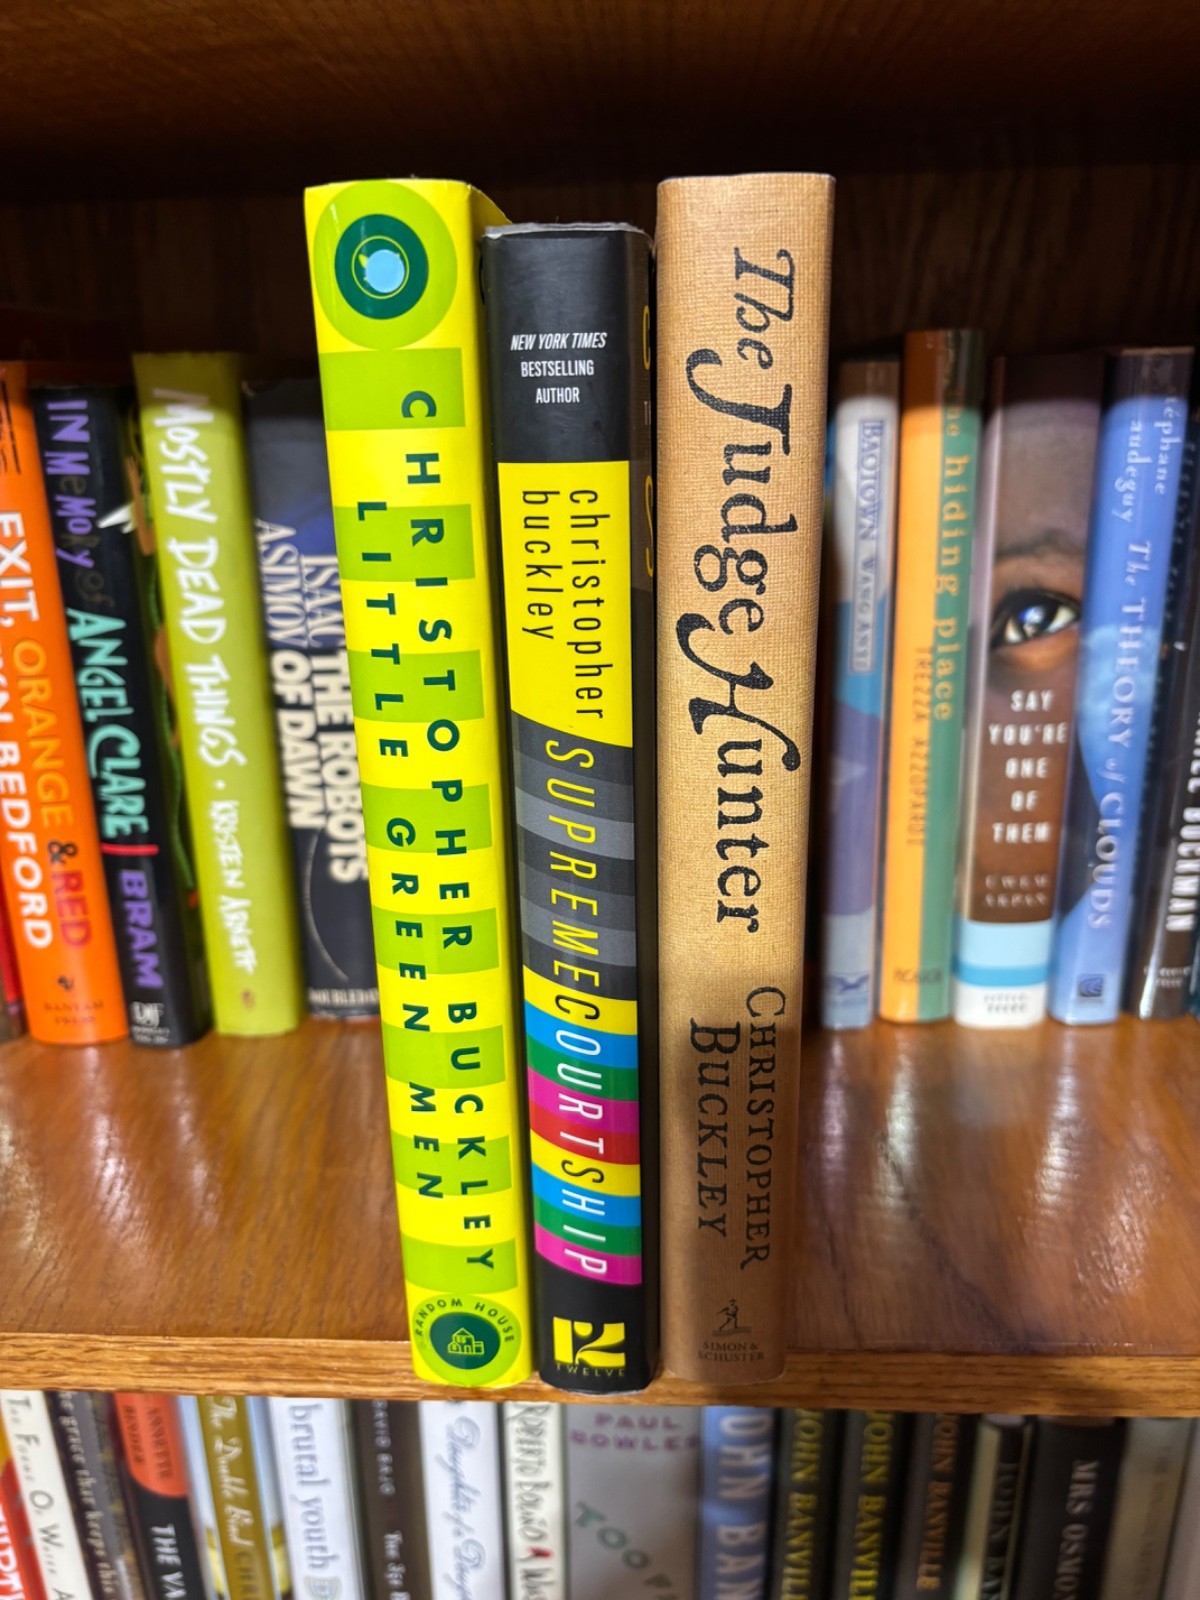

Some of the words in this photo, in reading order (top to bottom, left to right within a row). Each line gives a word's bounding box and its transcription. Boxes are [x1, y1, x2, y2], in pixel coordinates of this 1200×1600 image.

[511, 334, 535, 351] NEW
[538, 333, 570, 350] YORK
[571, 332, 608, 349] TIMES
[734, 247, 796, 369] The
[520, 360, 595, 378] BESTSELLING
[535, 387, 581, 404] AUTHOR
[46, 399, 90, 443] IN
[152, 388, 217, 524] MOSTLY
[1154, 395, 1183, 496] téphane
[685, 348, 798, 635] Judge
[937, 453, 971, 597] hiding
[167, 536, 227, 644] DEAD
[254, 518, 308, 648] ASIMOV
[301, 554, 346, 647] ISAAC
[521, 490, 563, 640] buckley
[567, 489, 614, 719] christopher
[66, 608, 133, 722] ANGEL
[271, 650, 314, 704] OF
[312, 650, 354, 732] THE
[931, 616, 959, 720] place
[1010, 689, 1055, 712] SAY
[12, 637, 73, 828] ORANGE
[186, 655, 247, 766] THINGS
[988, 722, 1068, 746] YOU'RE
[88, 724, 149, 838] CLARE
[277, 709, 325, 829] DAWN
[320, 734, 370, 883] ROBOTS
[676, 612, 801, 933] Hunter
[1005, 757, 1049, 779] ONE
[1011, 790, 1038, 812] OF
[0, 739, 52, 949] BEDFORD
[47, 840, 78, 866] &
[358, 502, 409, 758] LITTLE
[386, 817, 430, 1032] GREEN
[409, 1082, 444, 1199] MEN
[401, 390, 473, 950] CHRISTOPHER
[448, 1001, 494, 1270] BUCKLEY
[992, 821, 1050, 844] THEM
[50, 869, 93, 949] RED
[119, 869, 163, 988] BRAM
[415, 1298, 462, 1337] RANDOM
[474, 1301, 515, 1343] HOUSE
[698, 1351, 764, 1361] SCHUSTER
[703, 1342, 747, 1351] SIMON
[556, 1363, 625, 1377] TWELVE
[288, 1403, 331, 1487] brutal
[594, 1412, 681, 1431] PAUL
[718, 1413, 775, 1499] OHN
[151, 1523, 182, 1566] THE
[290, 1494, 340, 1571] youth
